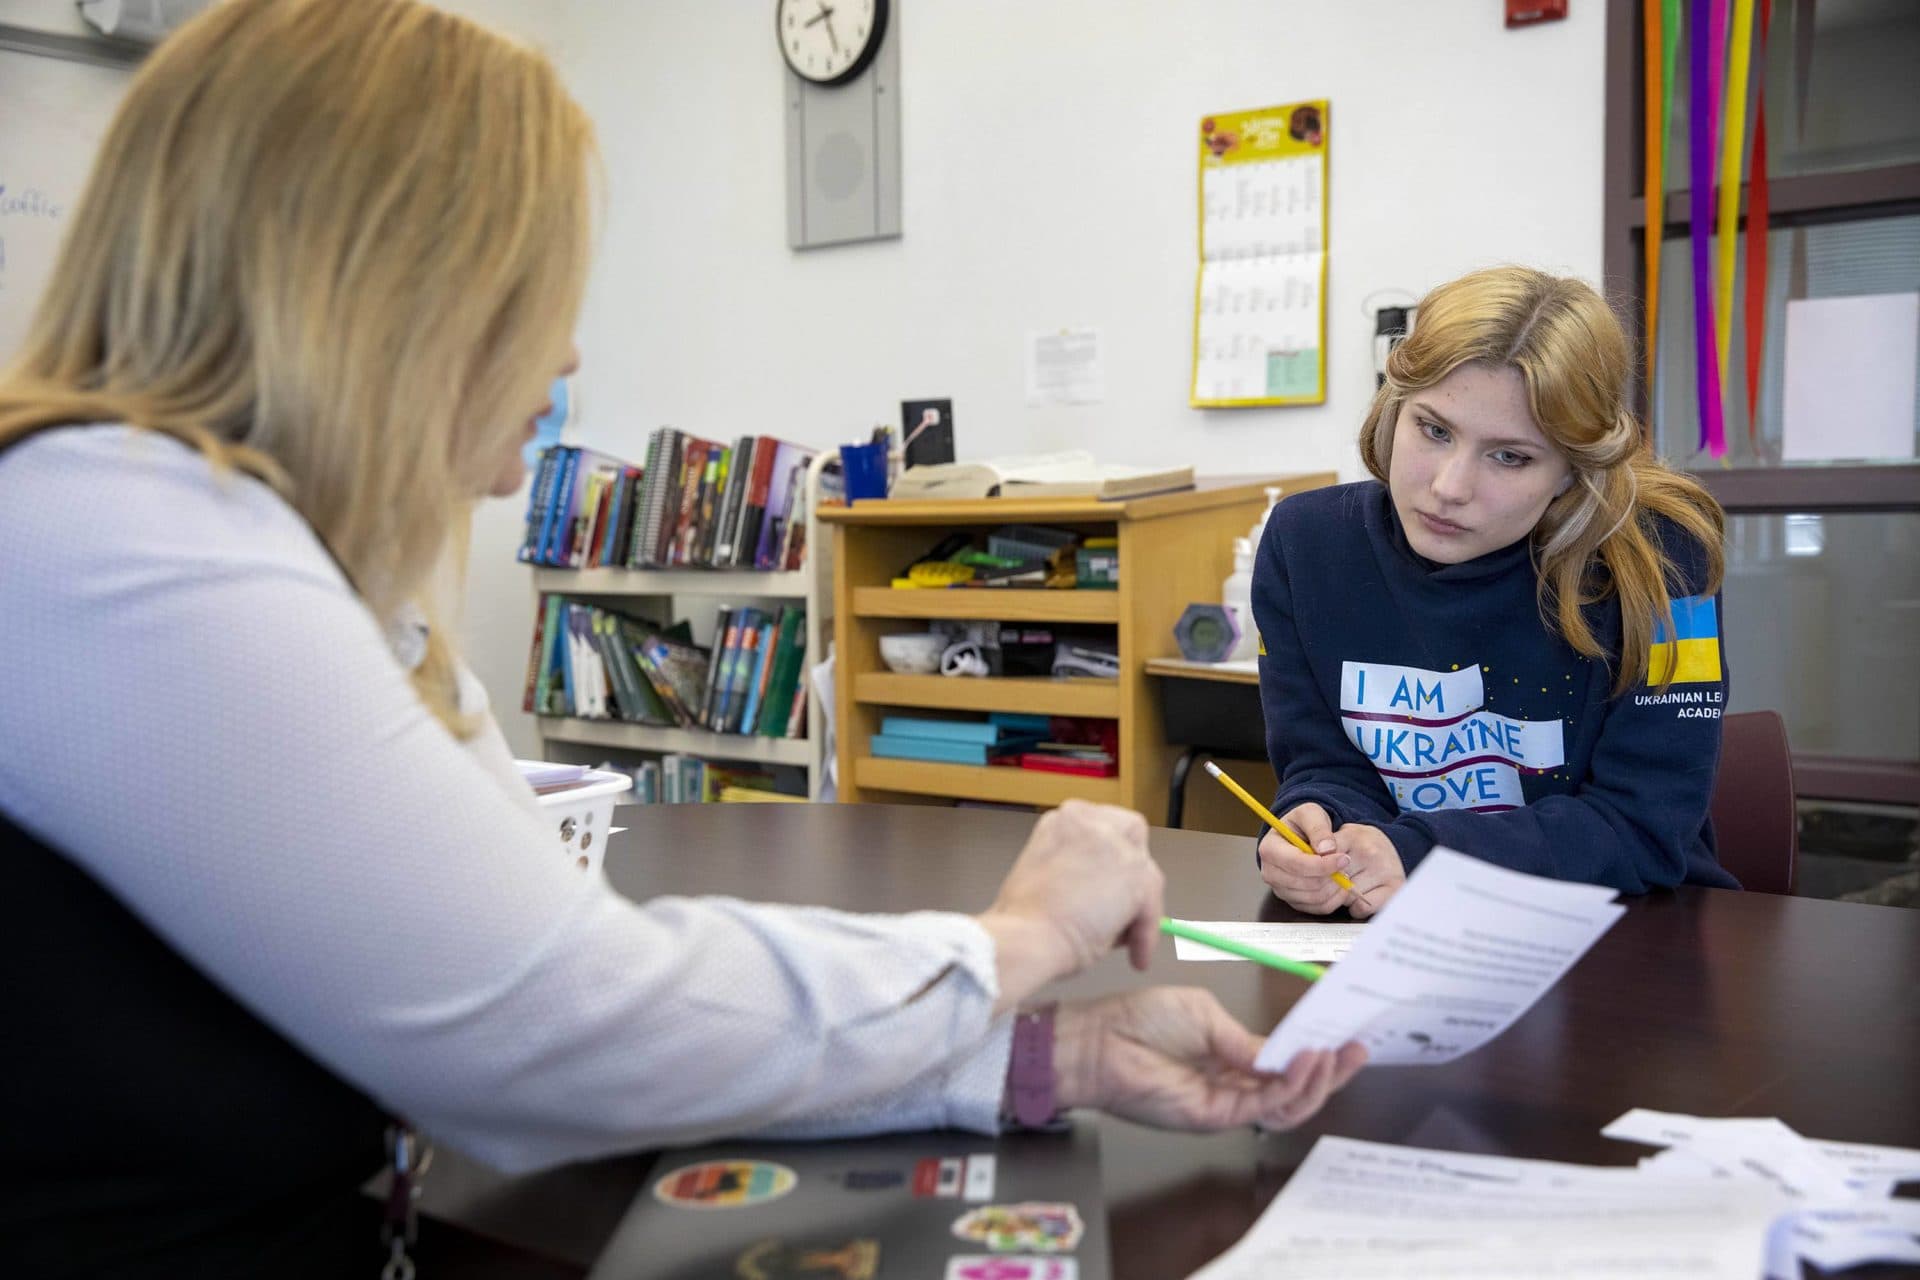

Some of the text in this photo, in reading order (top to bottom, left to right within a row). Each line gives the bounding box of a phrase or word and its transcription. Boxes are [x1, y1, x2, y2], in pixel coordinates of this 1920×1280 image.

[1357, 670, 1444, 713] I AM
[1635, 691, 1722, 706] UKRAINIAN LE
[1677, 707, 1720, 719] ACADE
